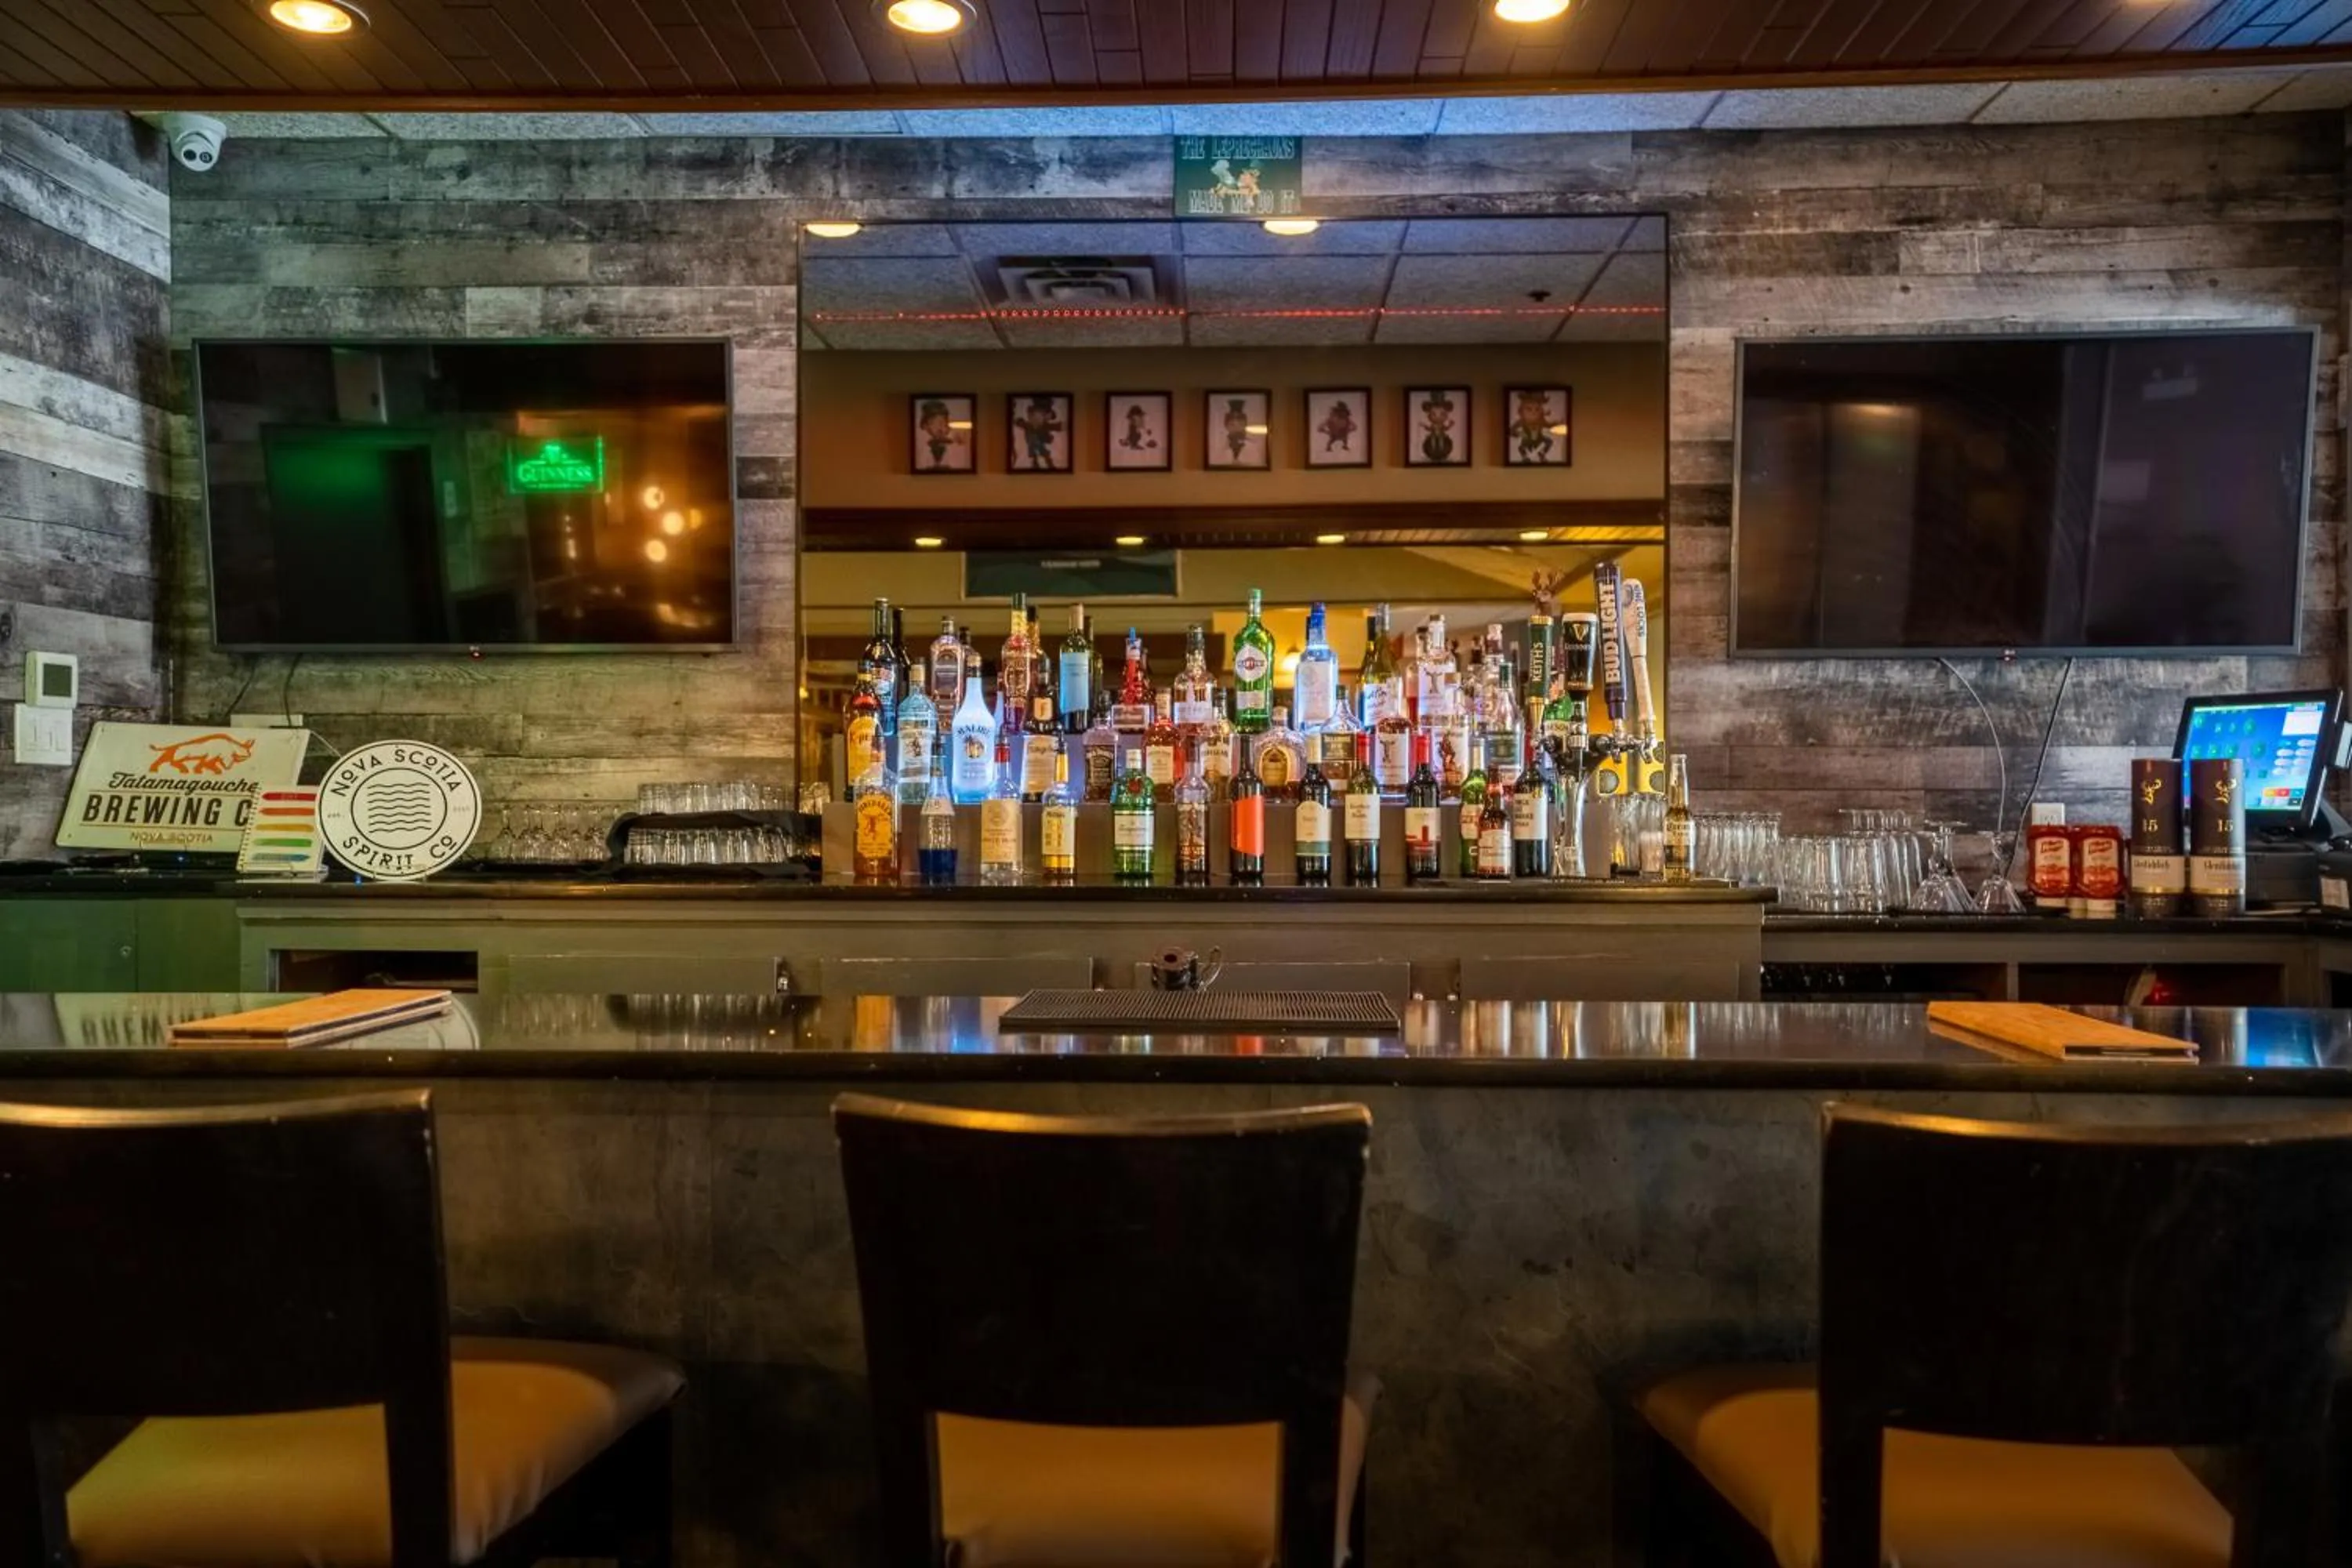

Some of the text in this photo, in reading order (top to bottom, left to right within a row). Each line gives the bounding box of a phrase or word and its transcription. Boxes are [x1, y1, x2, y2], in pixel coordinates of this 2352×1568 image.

[1181, 136, 1294, 159] THE LEPRECHAUNS
[1189, 190, 1224, 214] MADE
[1257, 190, 1274, 214] DO
[1598, 581, 1621, 684] BUD LIGHT
[108, 771, 260, 796] Tatamagouche
[330, 749, 462, 797] NOVA SCOTIA
[82, 793, 252, 827] BREWING C
[2142, 818, 2158, 832] 15
[2217, 818, 2234, 832] 15
[129, 831, 213, 844] NOVA SCOTIA
[343, 835, 457, 870] SPIRIT CO
